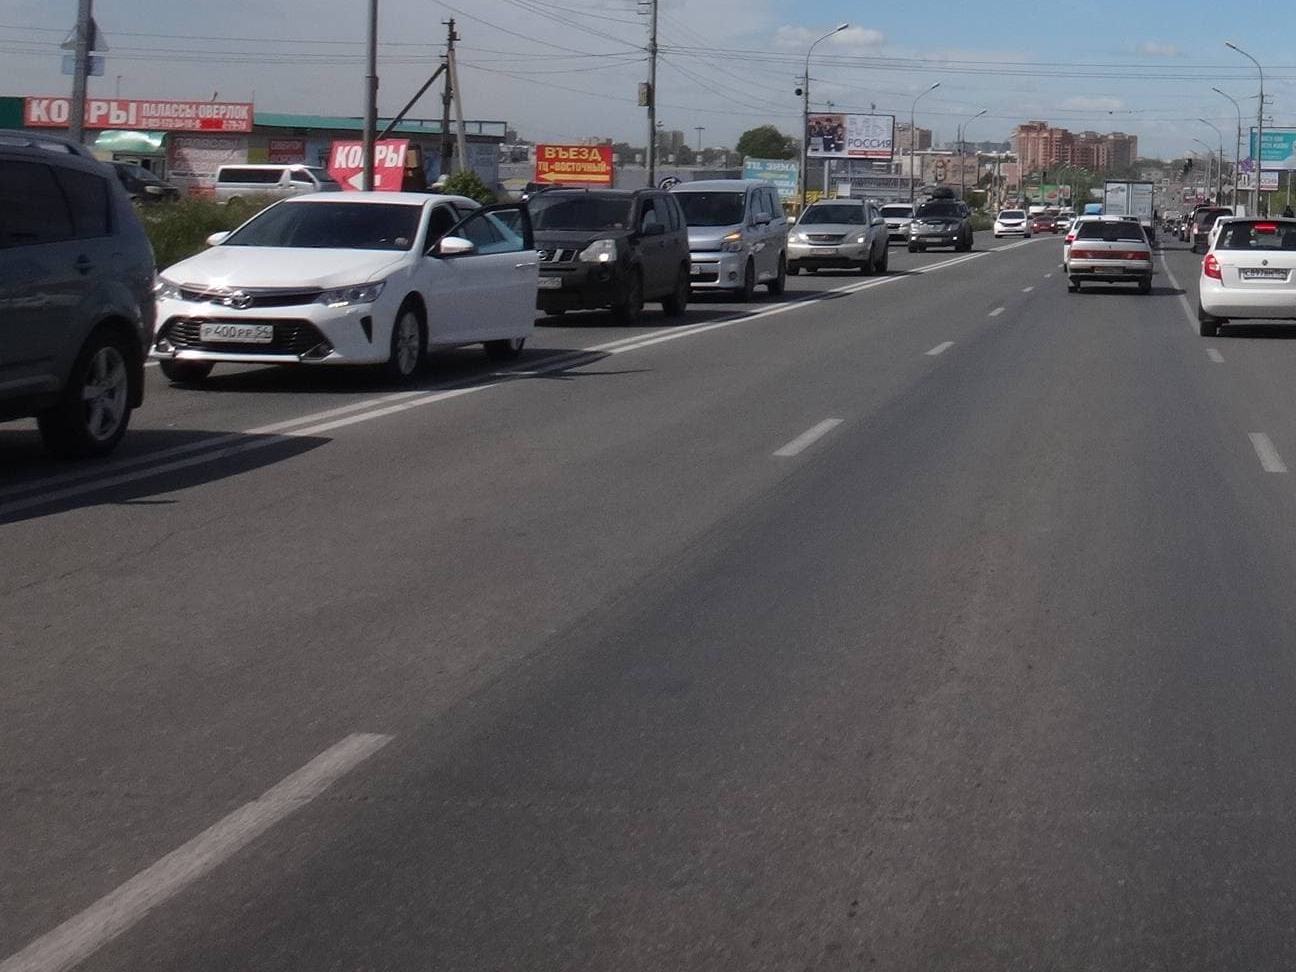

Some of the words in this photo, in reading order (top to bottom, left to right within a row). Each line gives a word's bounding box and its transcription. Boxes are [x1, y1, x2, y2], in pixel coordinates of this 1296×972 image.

[30, 98, 137, 126] КОРЫ
[848, 138, 892, 148] РОССИЯ
[334, 144, 407, 168] КОРЫ
[544, 147, 602, 161] ВЪЕЗД
